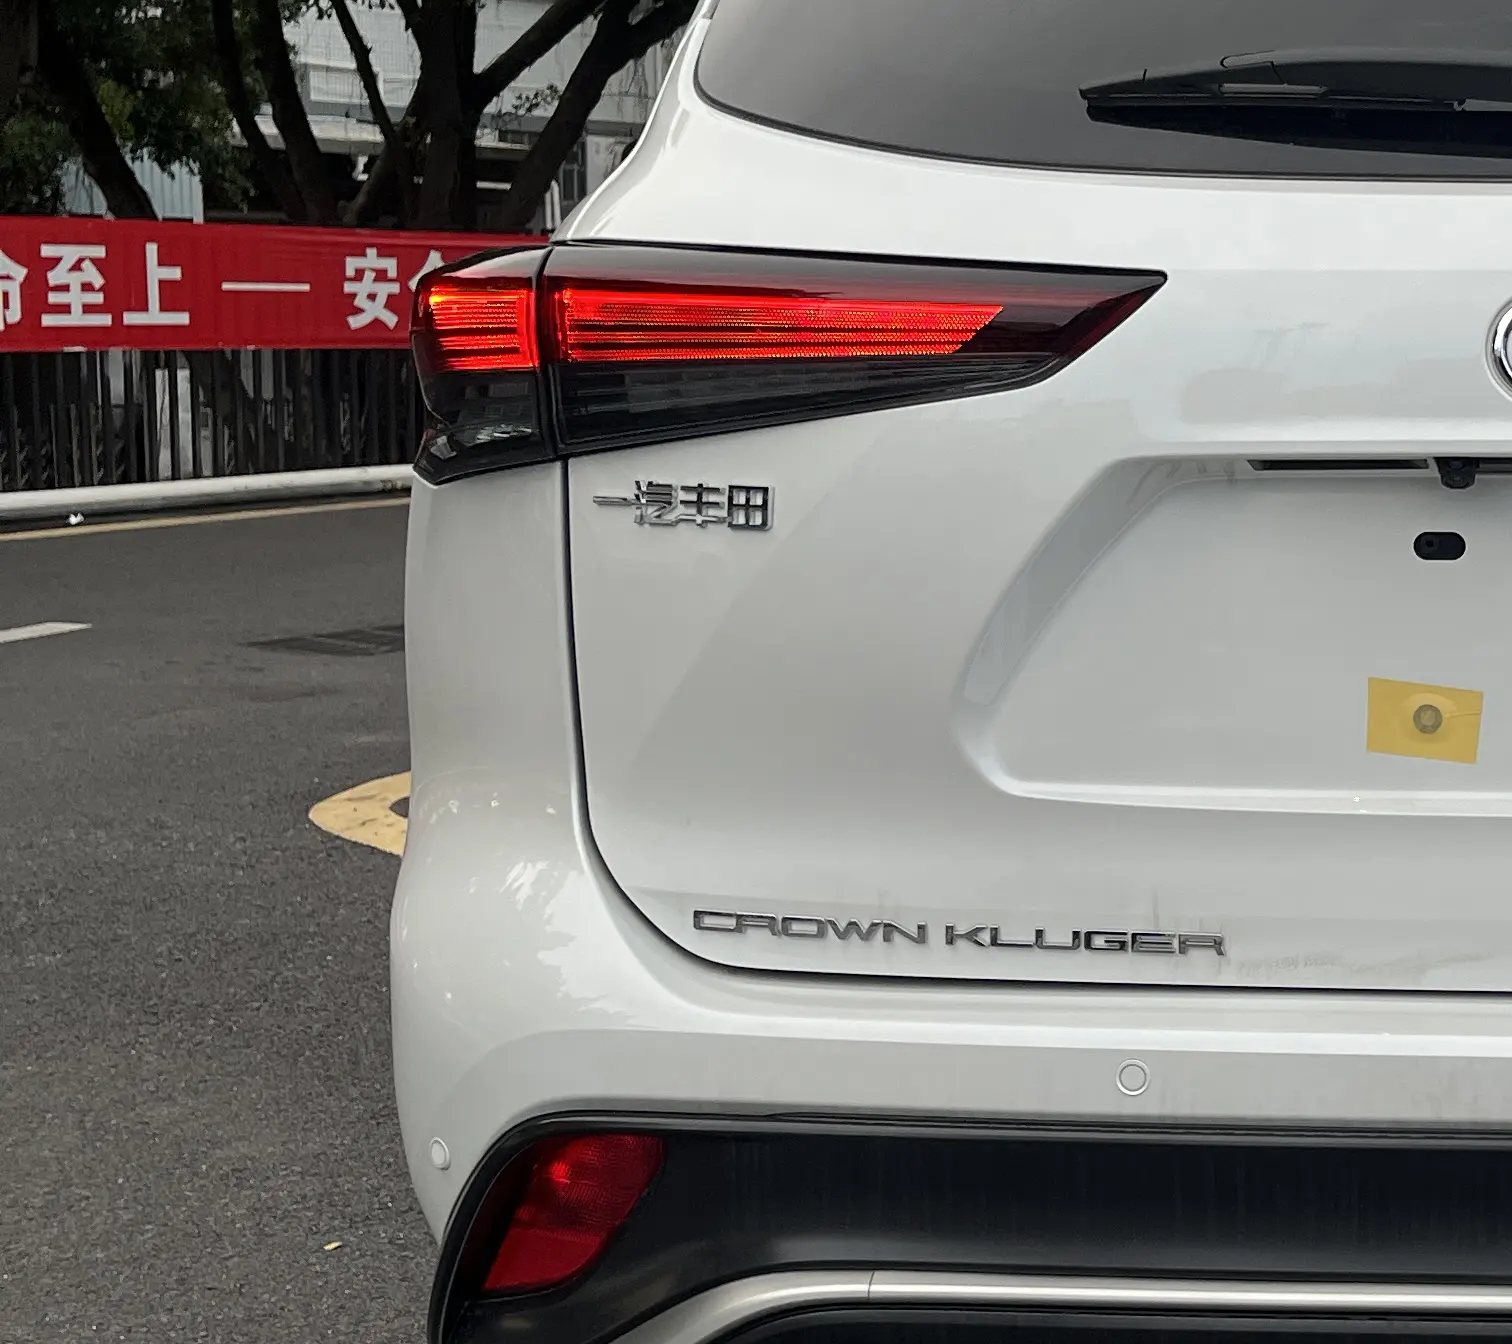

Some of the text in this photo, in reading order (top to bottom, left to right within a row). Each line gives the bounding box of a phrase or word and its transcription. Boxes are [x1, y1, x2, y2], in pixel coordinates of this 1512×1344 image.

[592, 480, 775, 531] 一汽丰田
[692, 908, 1227, 956] CROWN KLUGER
